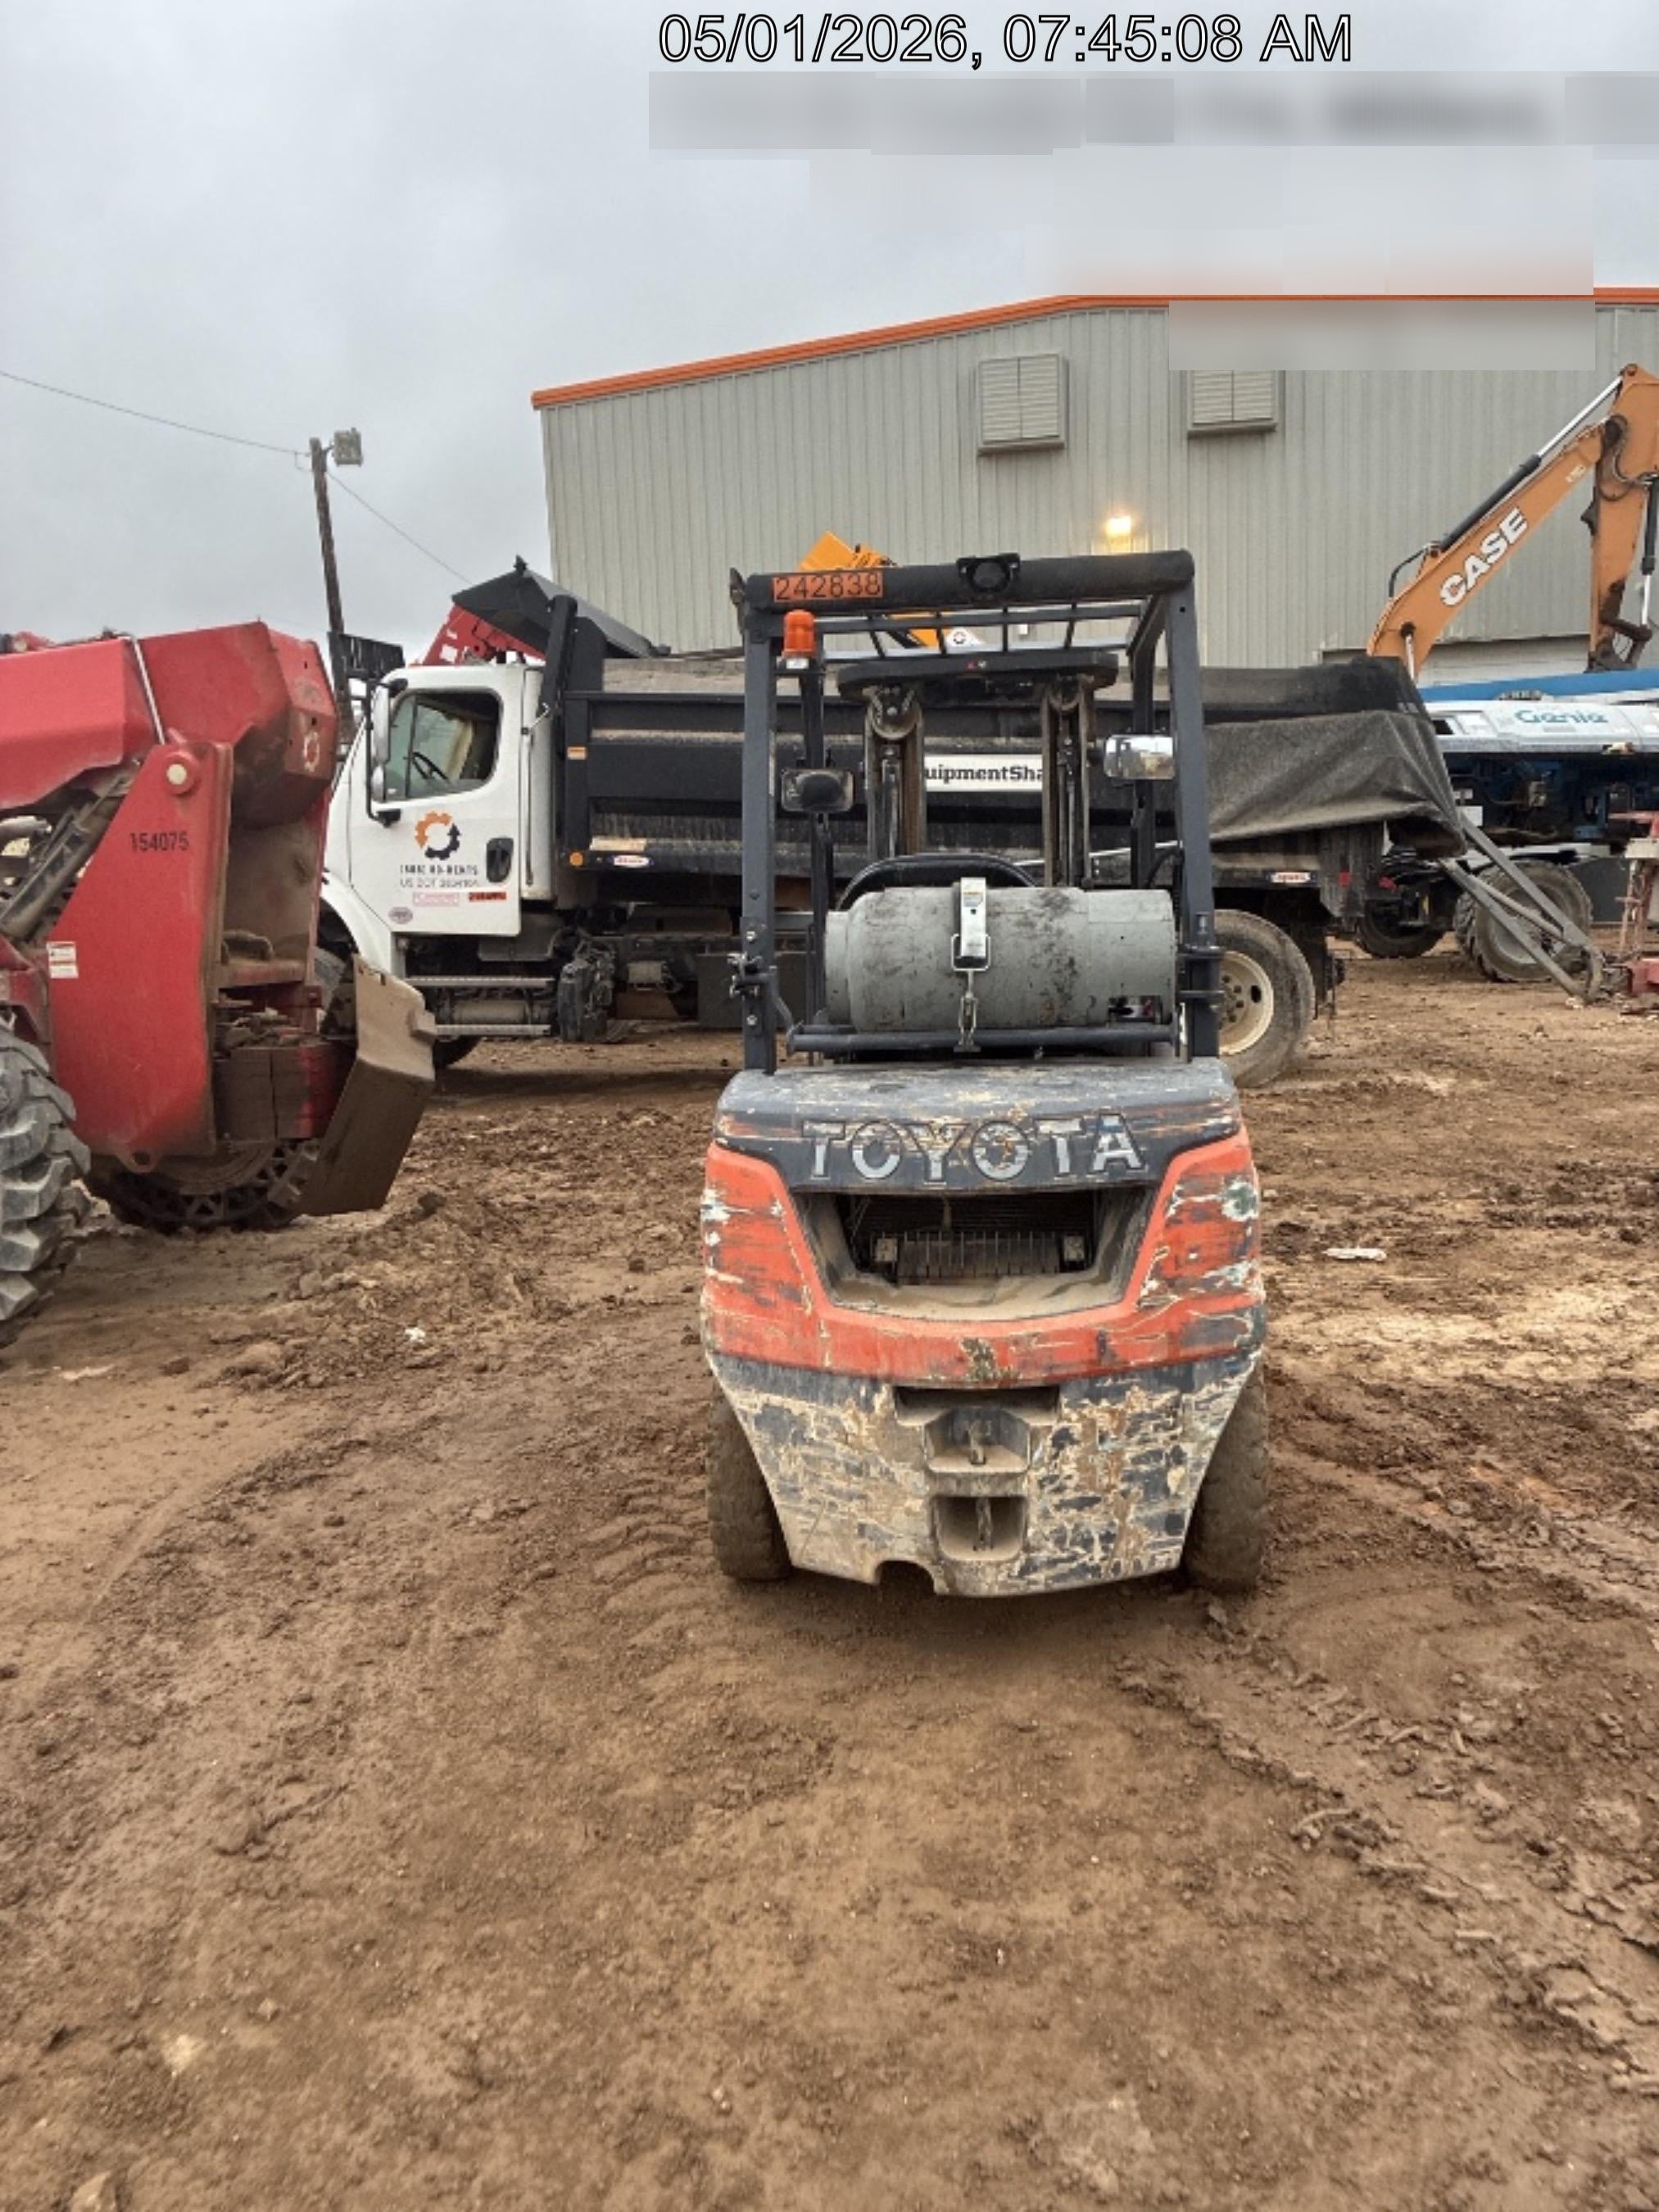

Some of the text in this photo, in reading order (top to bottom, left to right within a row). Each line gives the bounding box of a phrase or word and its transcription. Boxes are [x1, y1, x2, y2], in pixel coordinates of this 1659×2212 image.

[1440, 507, 1528, 606] CASE
[775, 572, 882, 600] 242838
[129, 830, 189, 852] 154075
[802, 1111, 1146, 1185] TOYOTA
